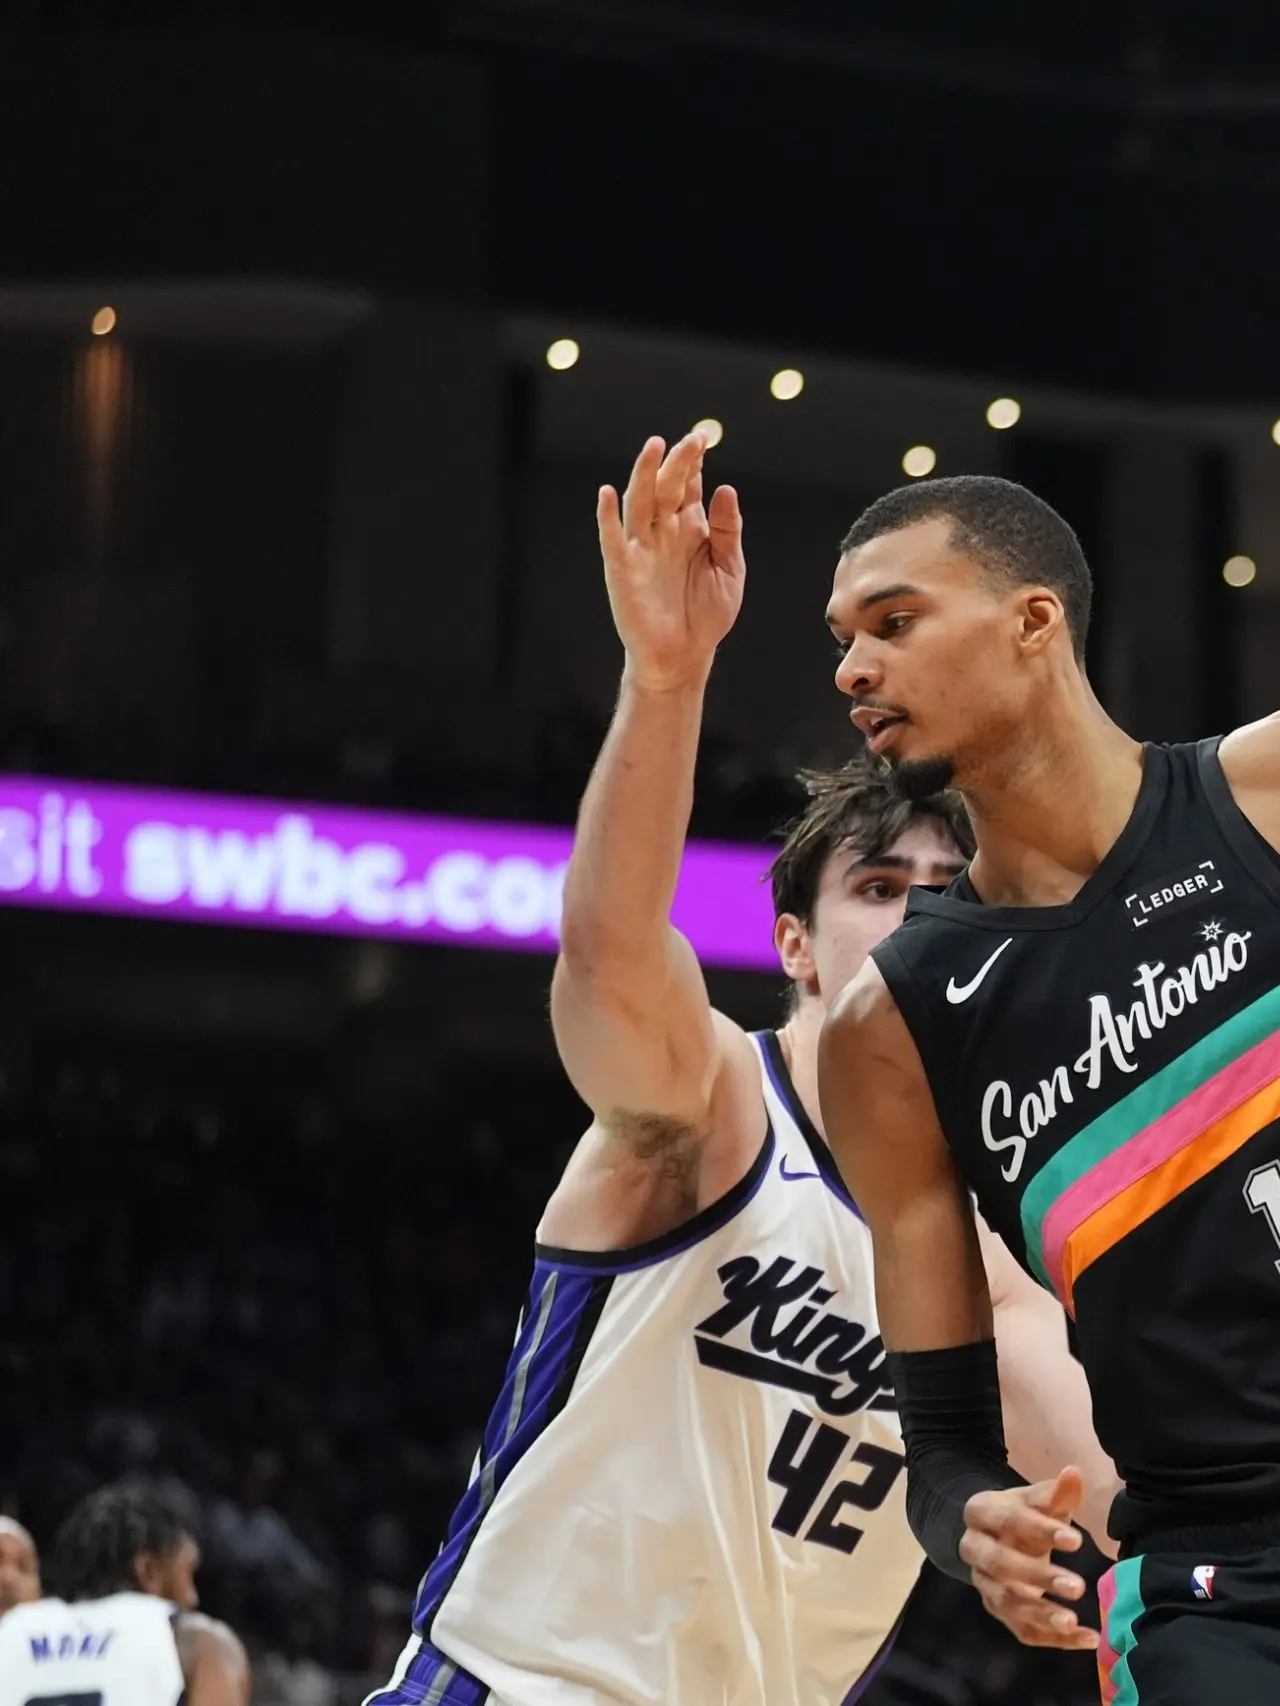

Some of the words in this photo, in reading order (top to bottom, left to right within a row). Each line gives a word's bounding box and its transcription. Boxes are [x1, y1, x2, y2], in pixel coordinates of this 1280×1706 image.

[122, 813, 566, 938] swbc.co
[1138, 873, 1209, 915] LEDGER
[981, 1066, 1074, 1183] San
[1073, 922, 1252, 1090] Antonio
[767, 1408, 907, 1556] 42
